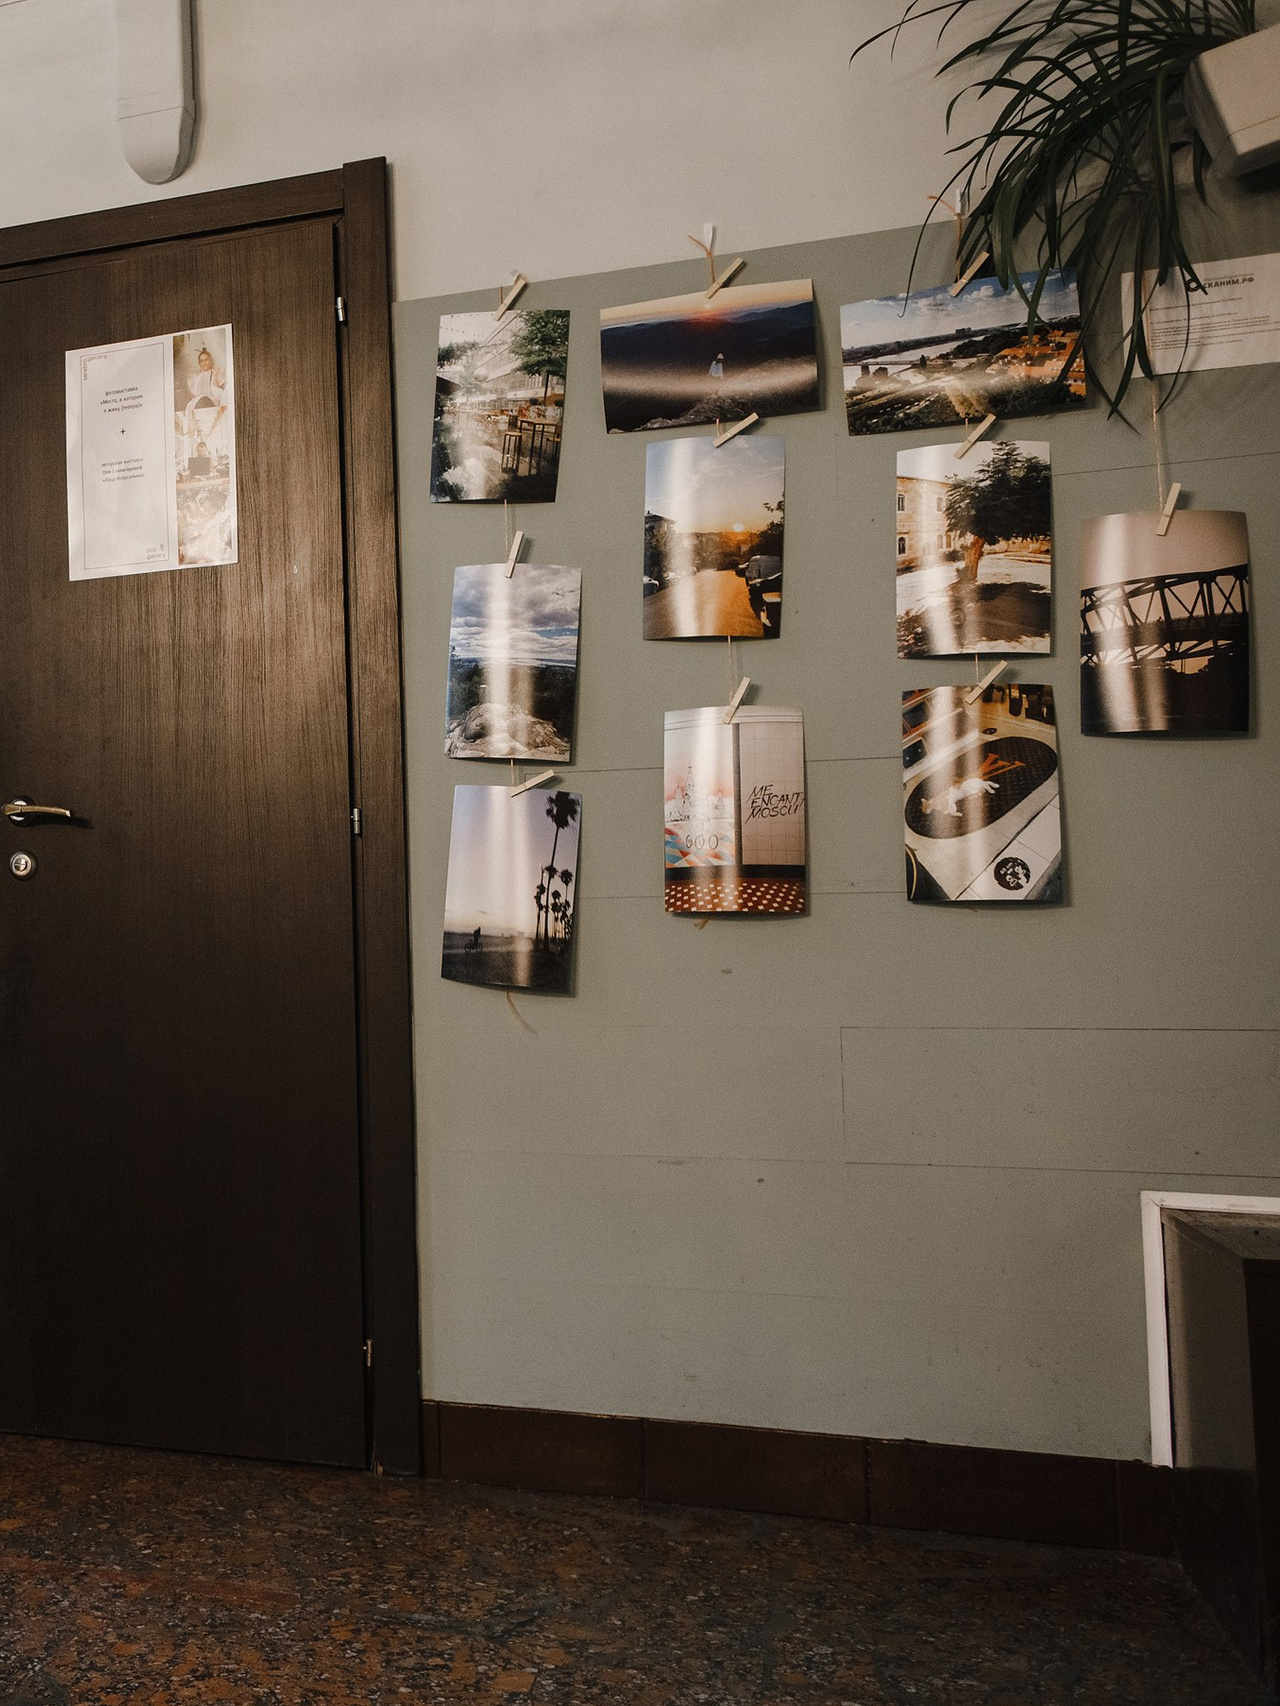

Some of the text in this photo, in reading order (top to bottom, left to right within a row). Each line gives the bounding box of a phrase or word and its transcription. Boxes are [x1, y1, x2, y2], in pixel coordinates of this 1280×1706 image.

[1203, 277, 1255, 289] СКАНИМ.РФ
[105, 386, 138, 397] фотовыставка
[746, 784, 773, 804] ME
